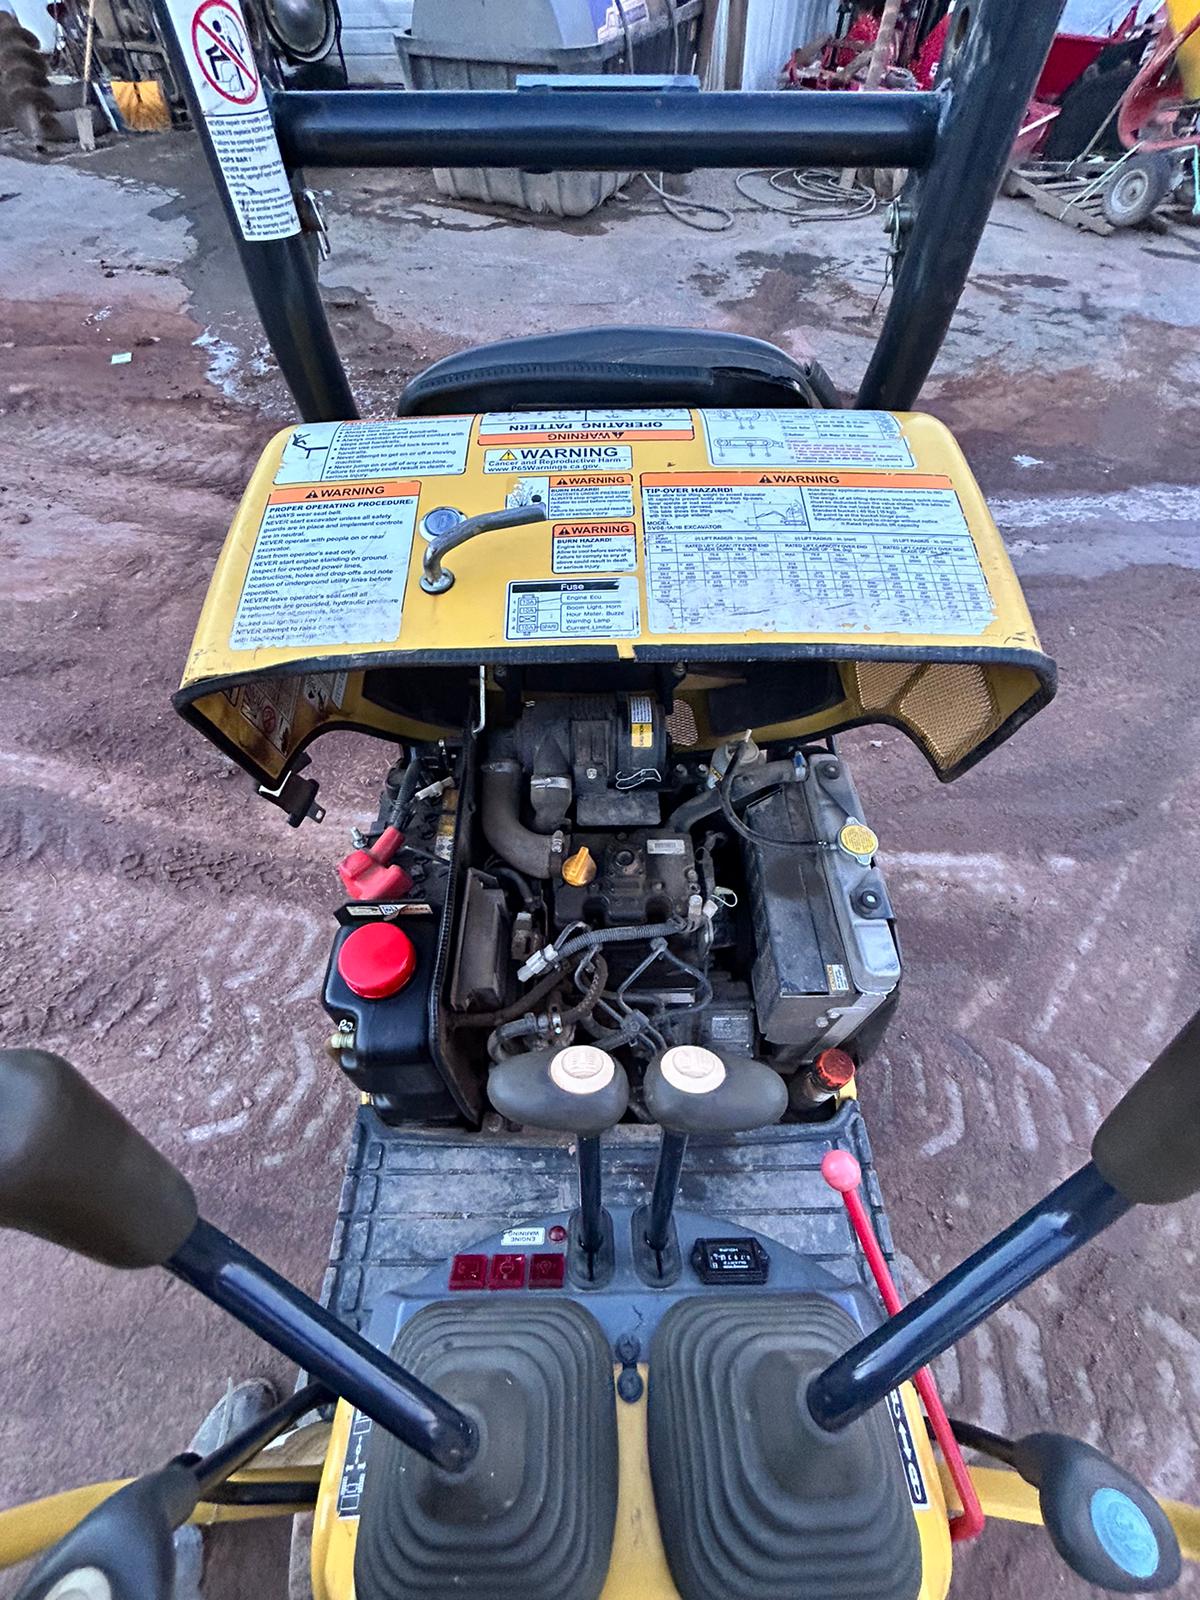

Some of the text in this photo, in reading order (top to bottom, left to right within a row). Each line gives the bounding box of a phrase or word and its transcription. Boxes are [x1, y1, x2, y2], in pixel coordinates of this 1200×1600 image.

[521, 447, 618, 459] WARNING
[773, 475, 840, 483] WARNING
[320, 486, 384, 497] WARNING
[572, 526, 630, 534] WARNING
